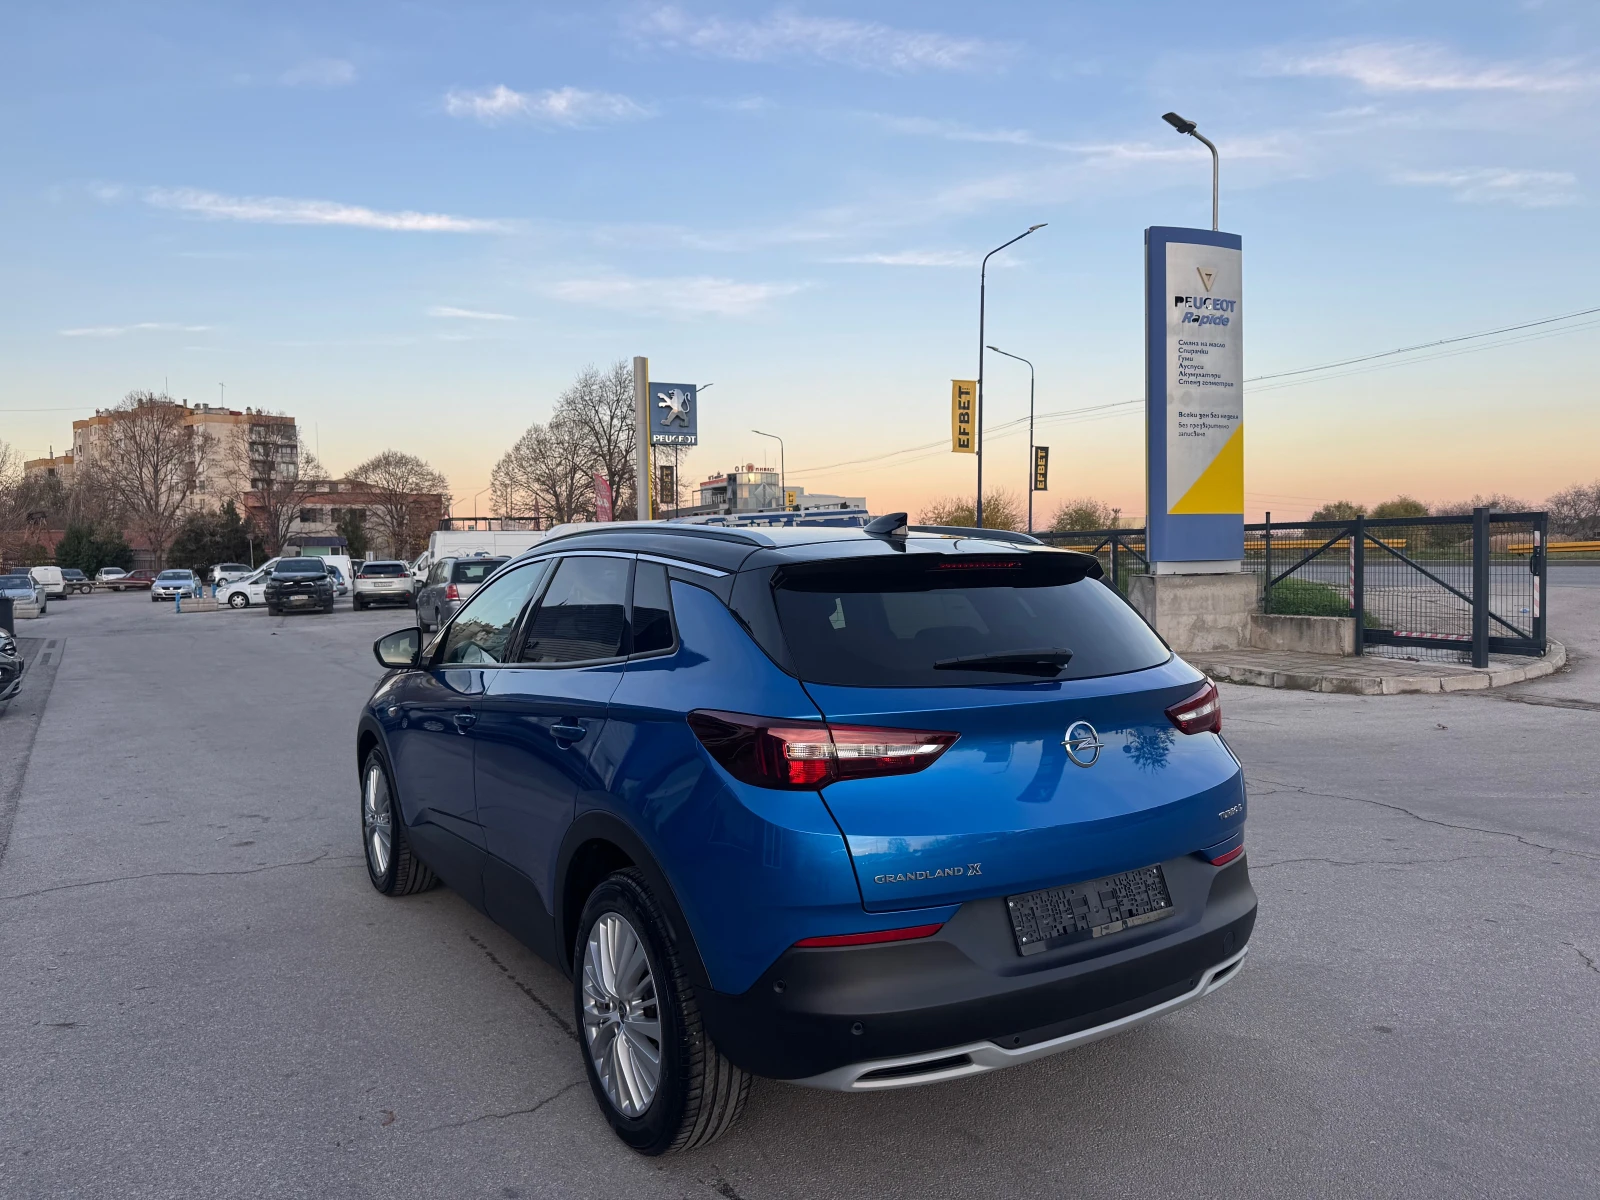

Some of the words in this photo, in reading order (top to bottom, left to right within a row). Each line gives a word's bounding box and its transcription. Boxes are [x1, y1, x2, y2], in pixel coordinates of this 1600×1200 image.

[1174, 296, 1237, 312] PEUGEOT
[1181, 312, 1230, 326] Rapide
[1178, 347, 1209, 355] Спирачки
[1178, 355, 1194, 363] Гуми
[958, 386, 970, 448] EFBET
[653, 434, 696, 444] PEUGEOT
[1037, 449, 1046, 488] EFBET
[874, 866, 964, 884] GRANDLAND
[967, 863, 982, 876] X
